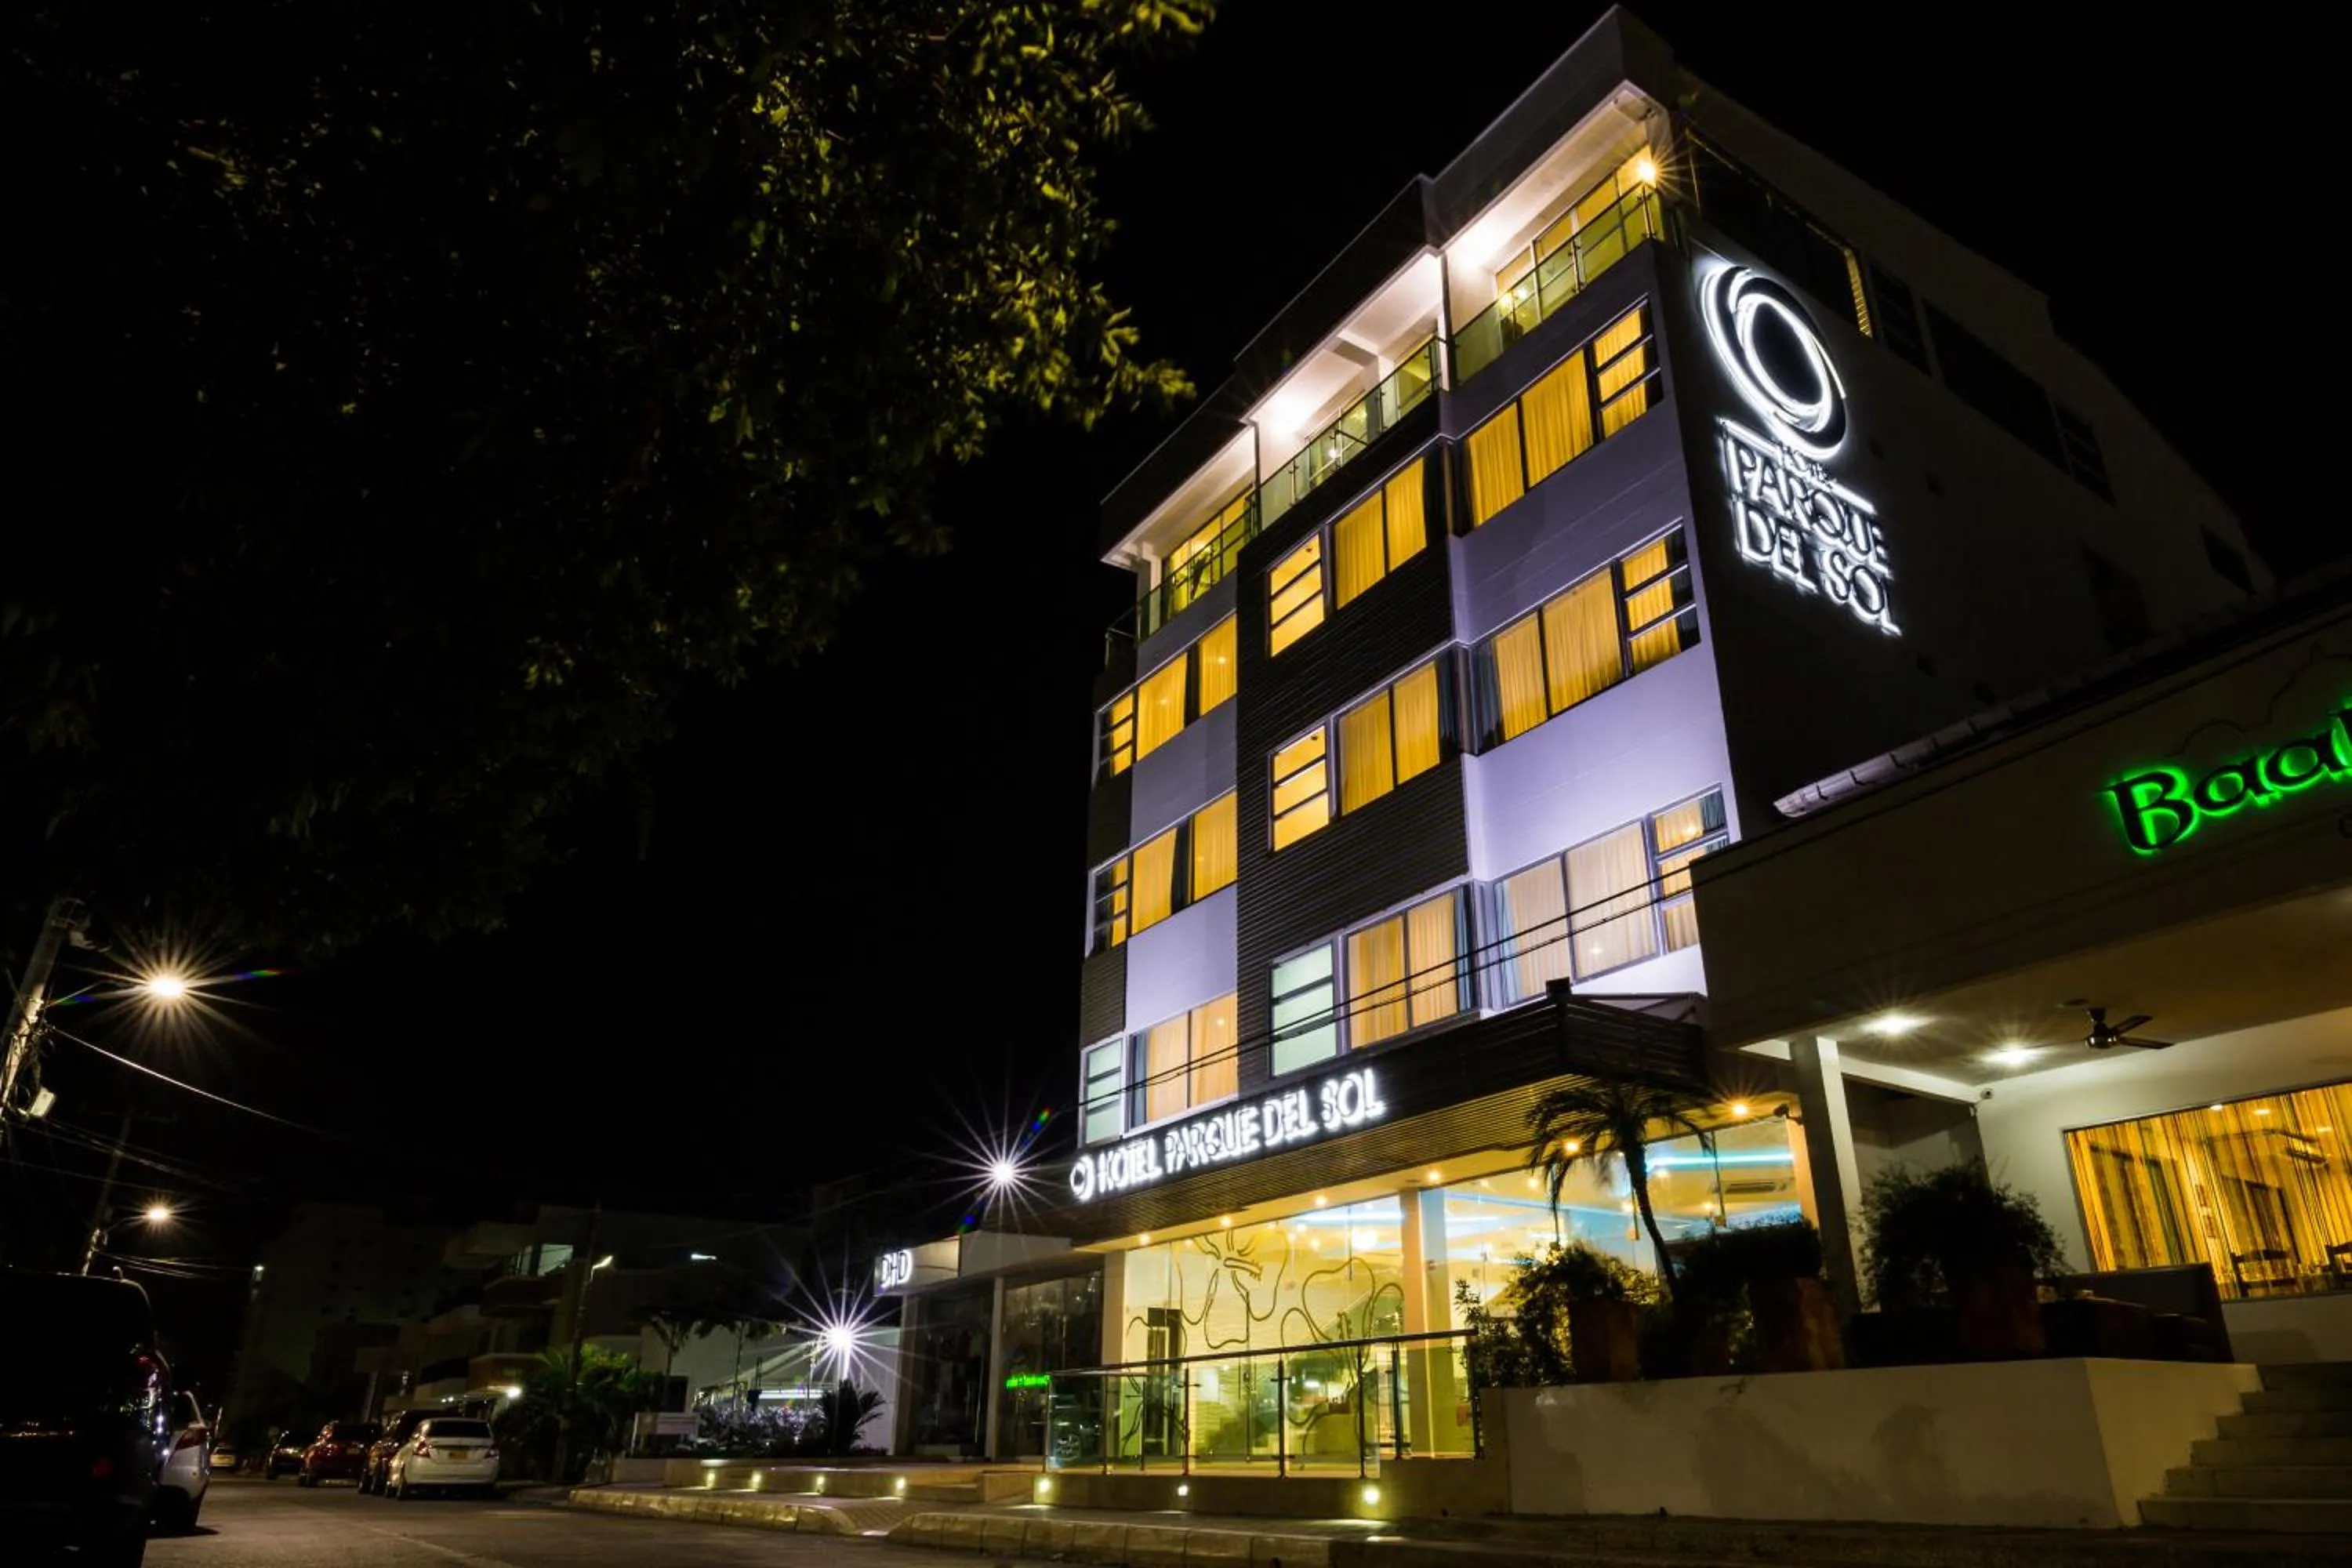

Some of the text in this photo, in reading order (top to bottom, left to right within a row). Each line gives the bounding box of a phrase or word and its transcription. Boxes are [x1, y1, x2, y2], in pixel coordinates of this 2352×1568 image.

[1727, 445, 1892, 579] PARQUE
[1736, 500, 1901, 636] DEL SOL
[2101, 706, 2352, 852] Baa
[1098, 1067, 1387, 1193] HOTEL PARQUE DEL SOL
